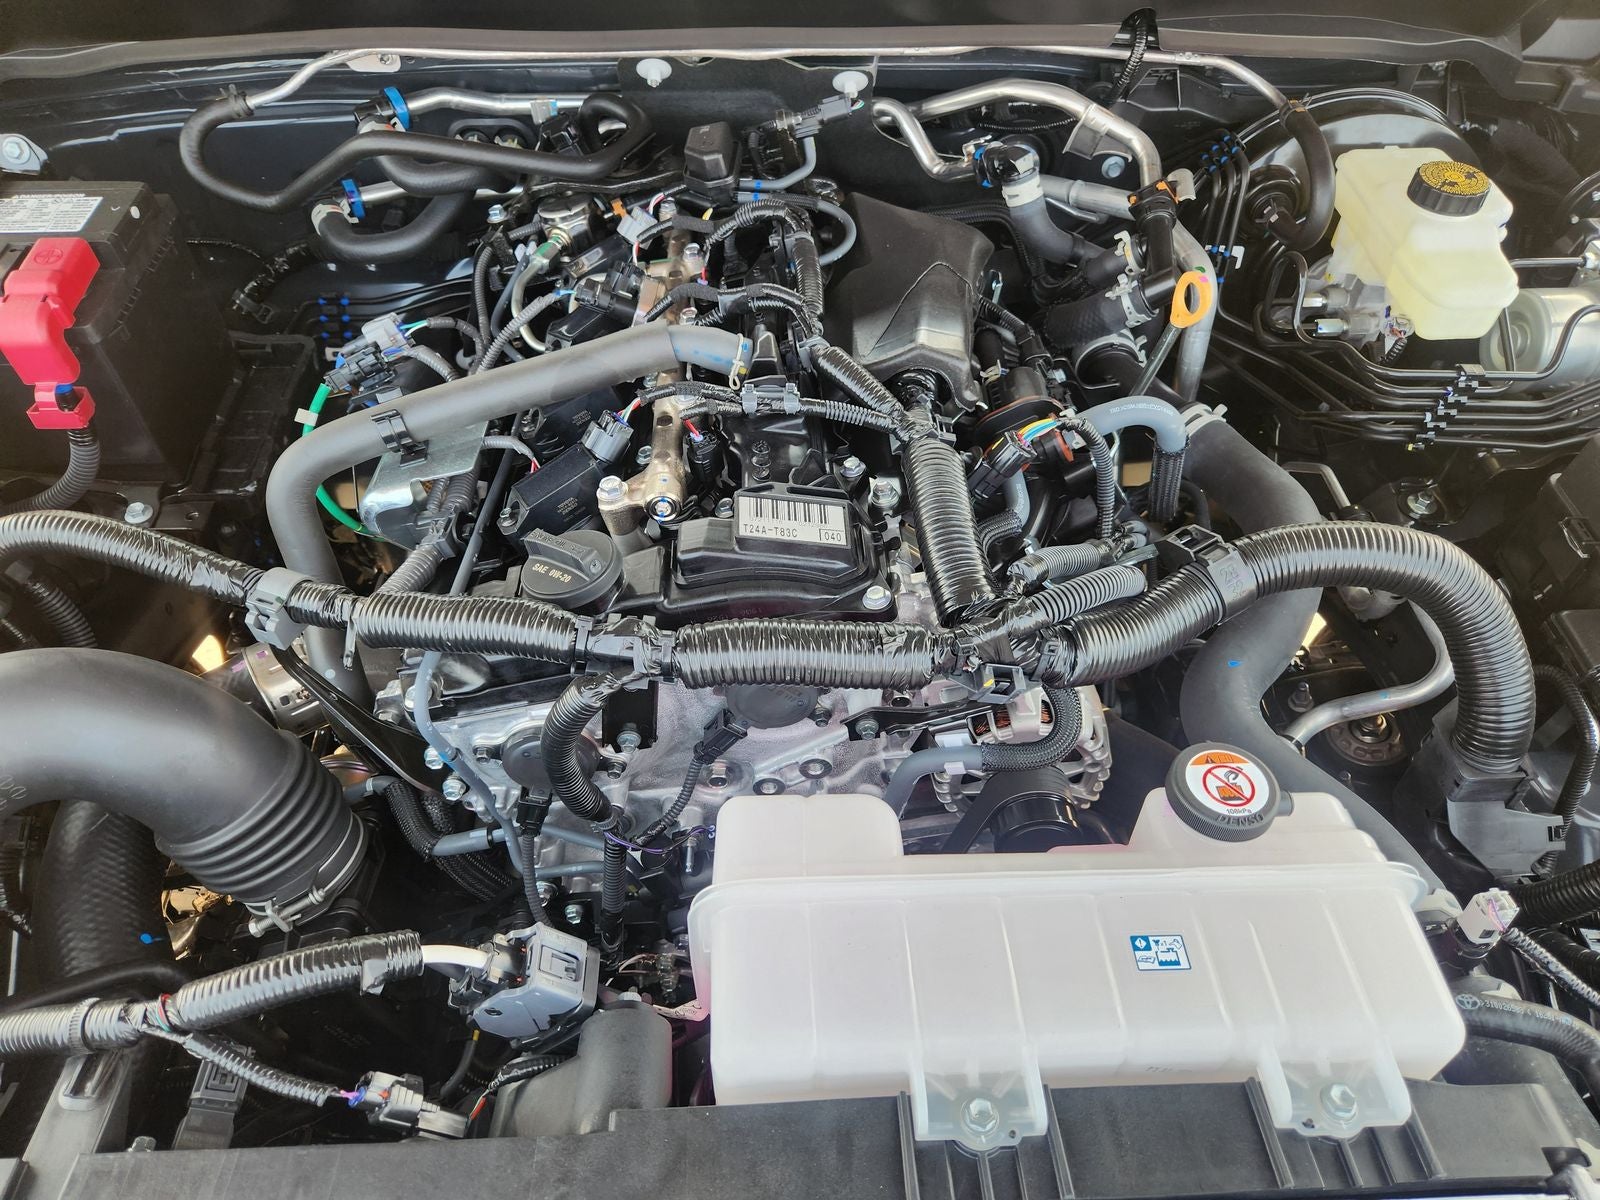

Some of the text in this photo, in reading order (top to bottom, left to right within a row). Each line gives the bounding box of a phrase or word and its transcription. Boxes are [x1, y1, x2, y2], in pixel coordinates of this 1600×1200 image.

[743, 523, 798, 538] T24A-T83C
[824, 531, 842, 542] 040
[532, 563, 572, 583] SAE 0W-20
[1217, 813, 1264, 827] DENSO
